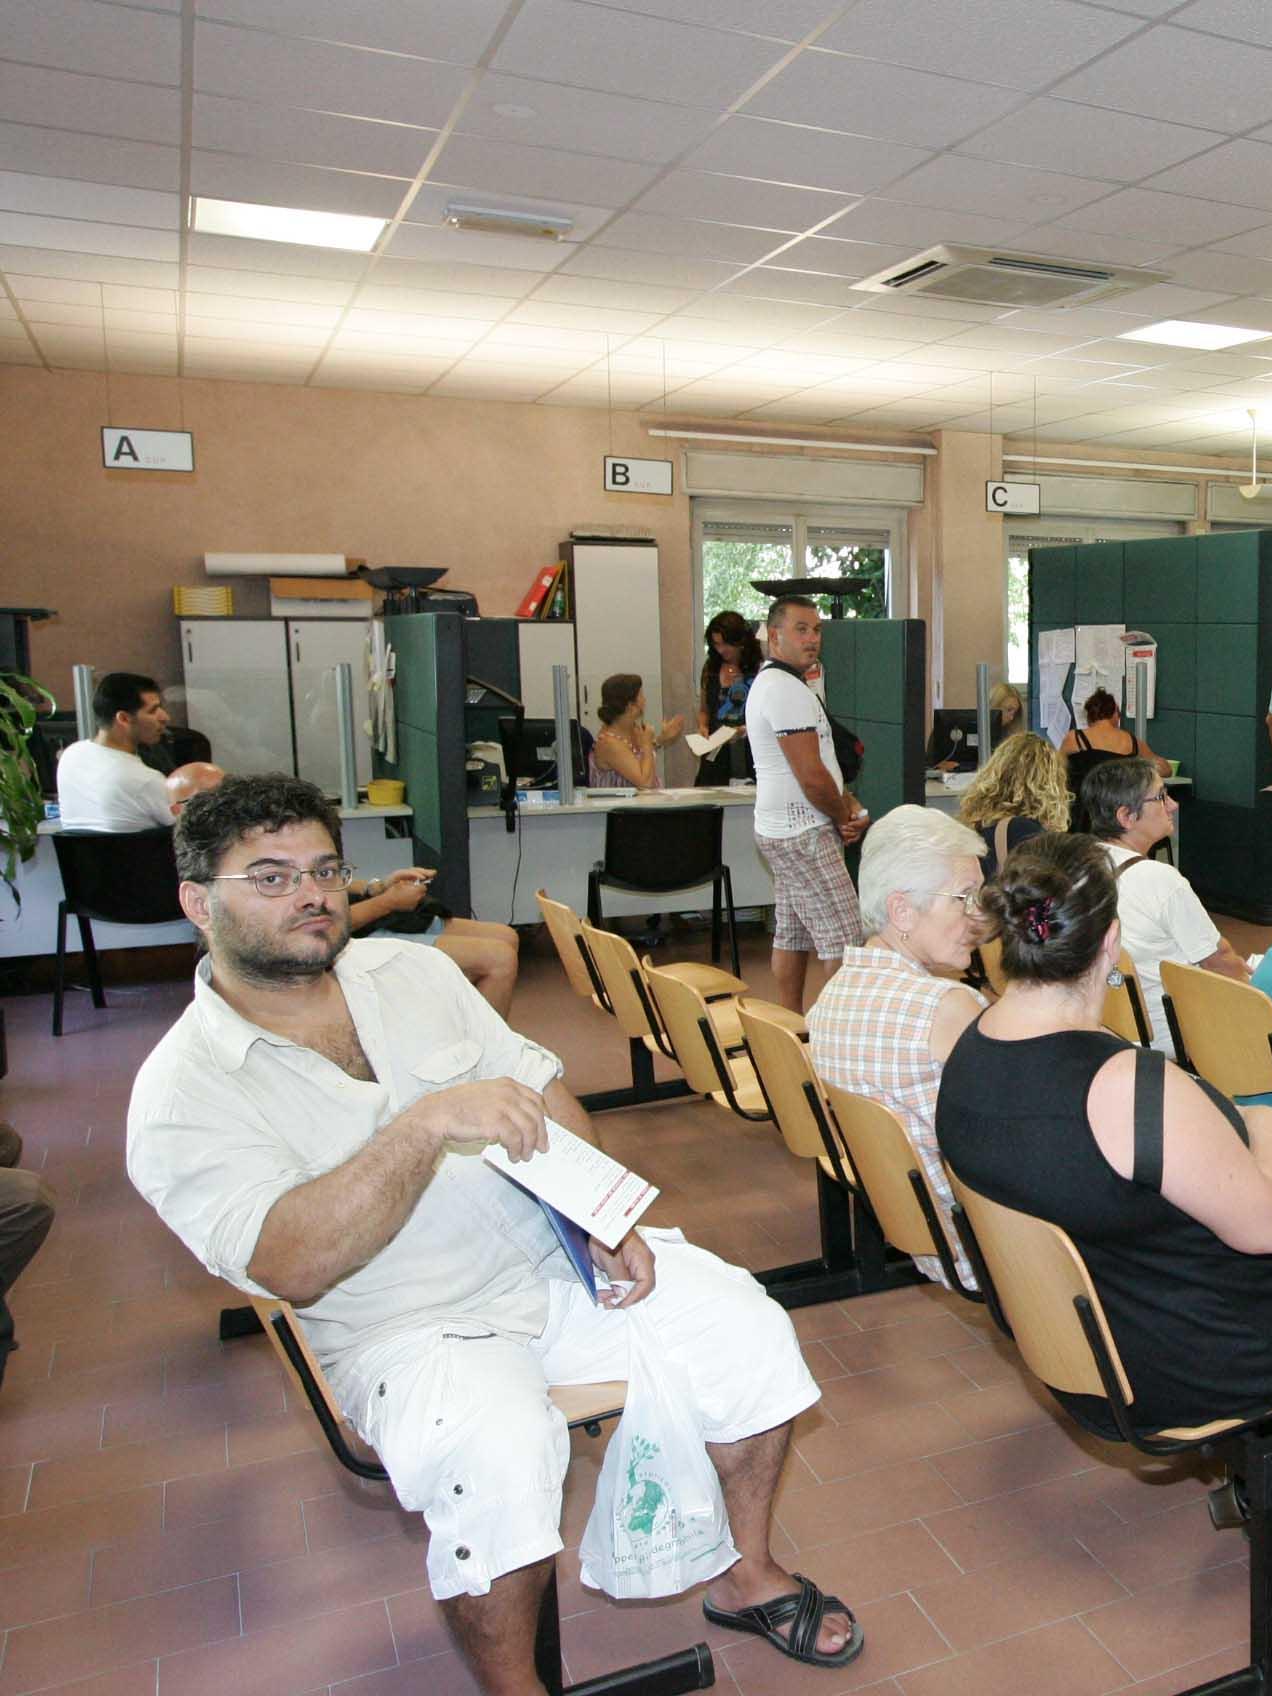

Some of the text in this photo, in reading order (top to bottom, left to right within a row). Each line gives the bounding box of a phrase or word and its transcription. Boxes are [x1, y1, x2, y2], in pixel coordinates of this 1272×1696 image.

[113, 435, 140, 461] A
[611, 463, 630, 486] B
[992, 486, 1008, 507] C
